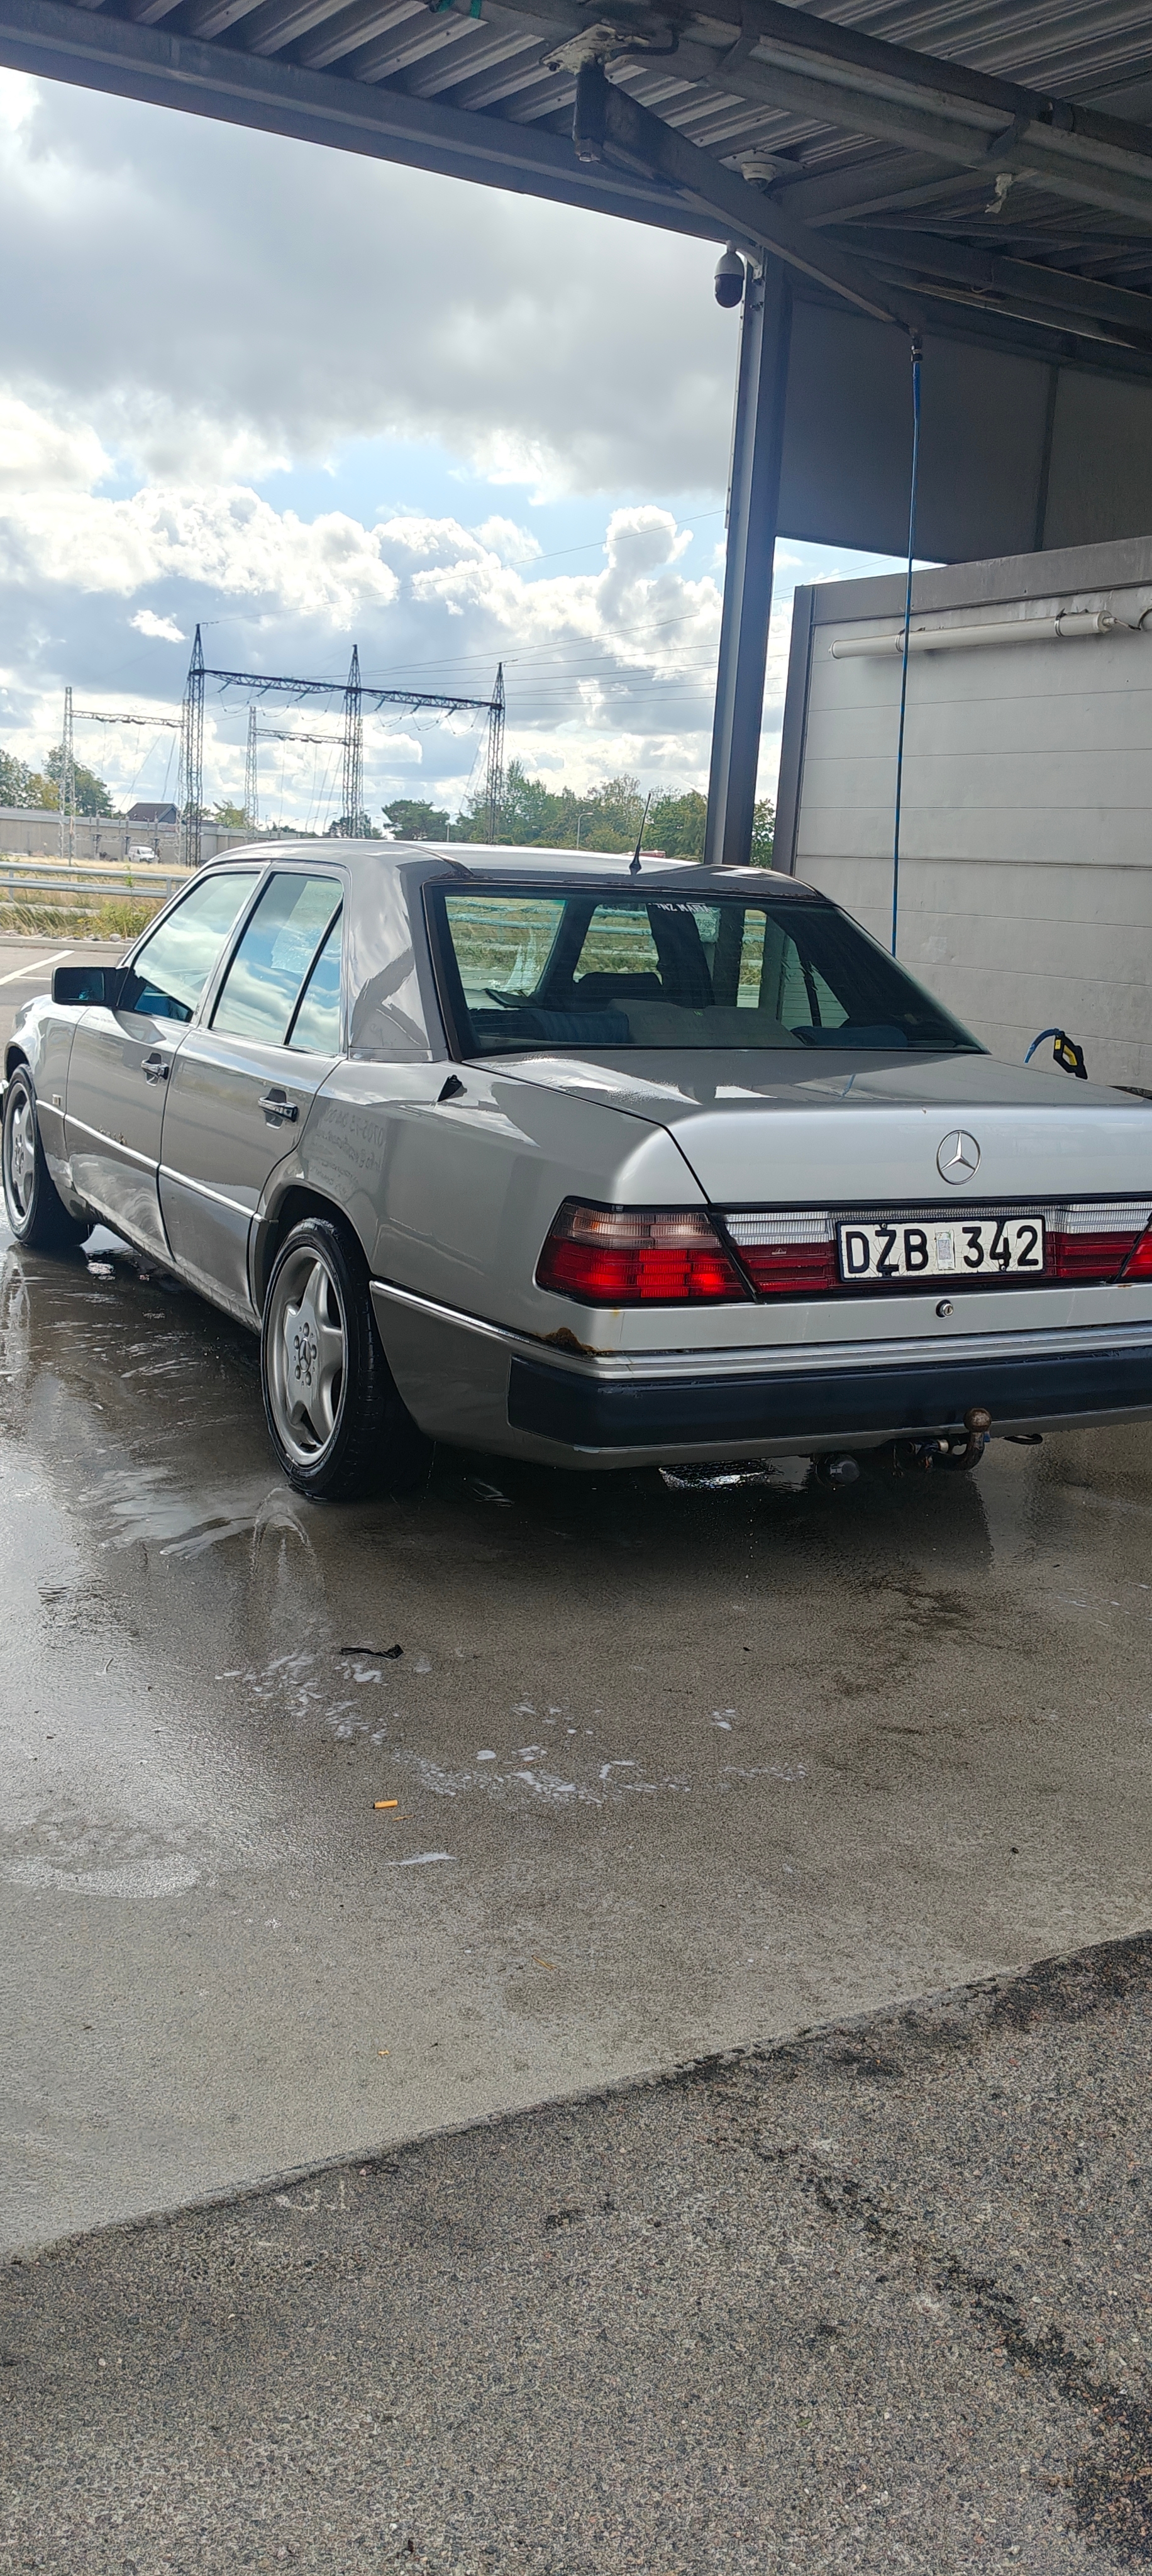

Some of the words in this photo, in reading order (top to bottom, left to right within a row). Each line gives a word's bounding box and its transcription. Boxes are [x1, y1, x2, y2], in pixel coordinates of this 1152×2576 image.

[676, 904, 711, 913] MAFIA
[846, 1228, 929, 1273] DZB
[962, 1224, 1039, 1272] 342
